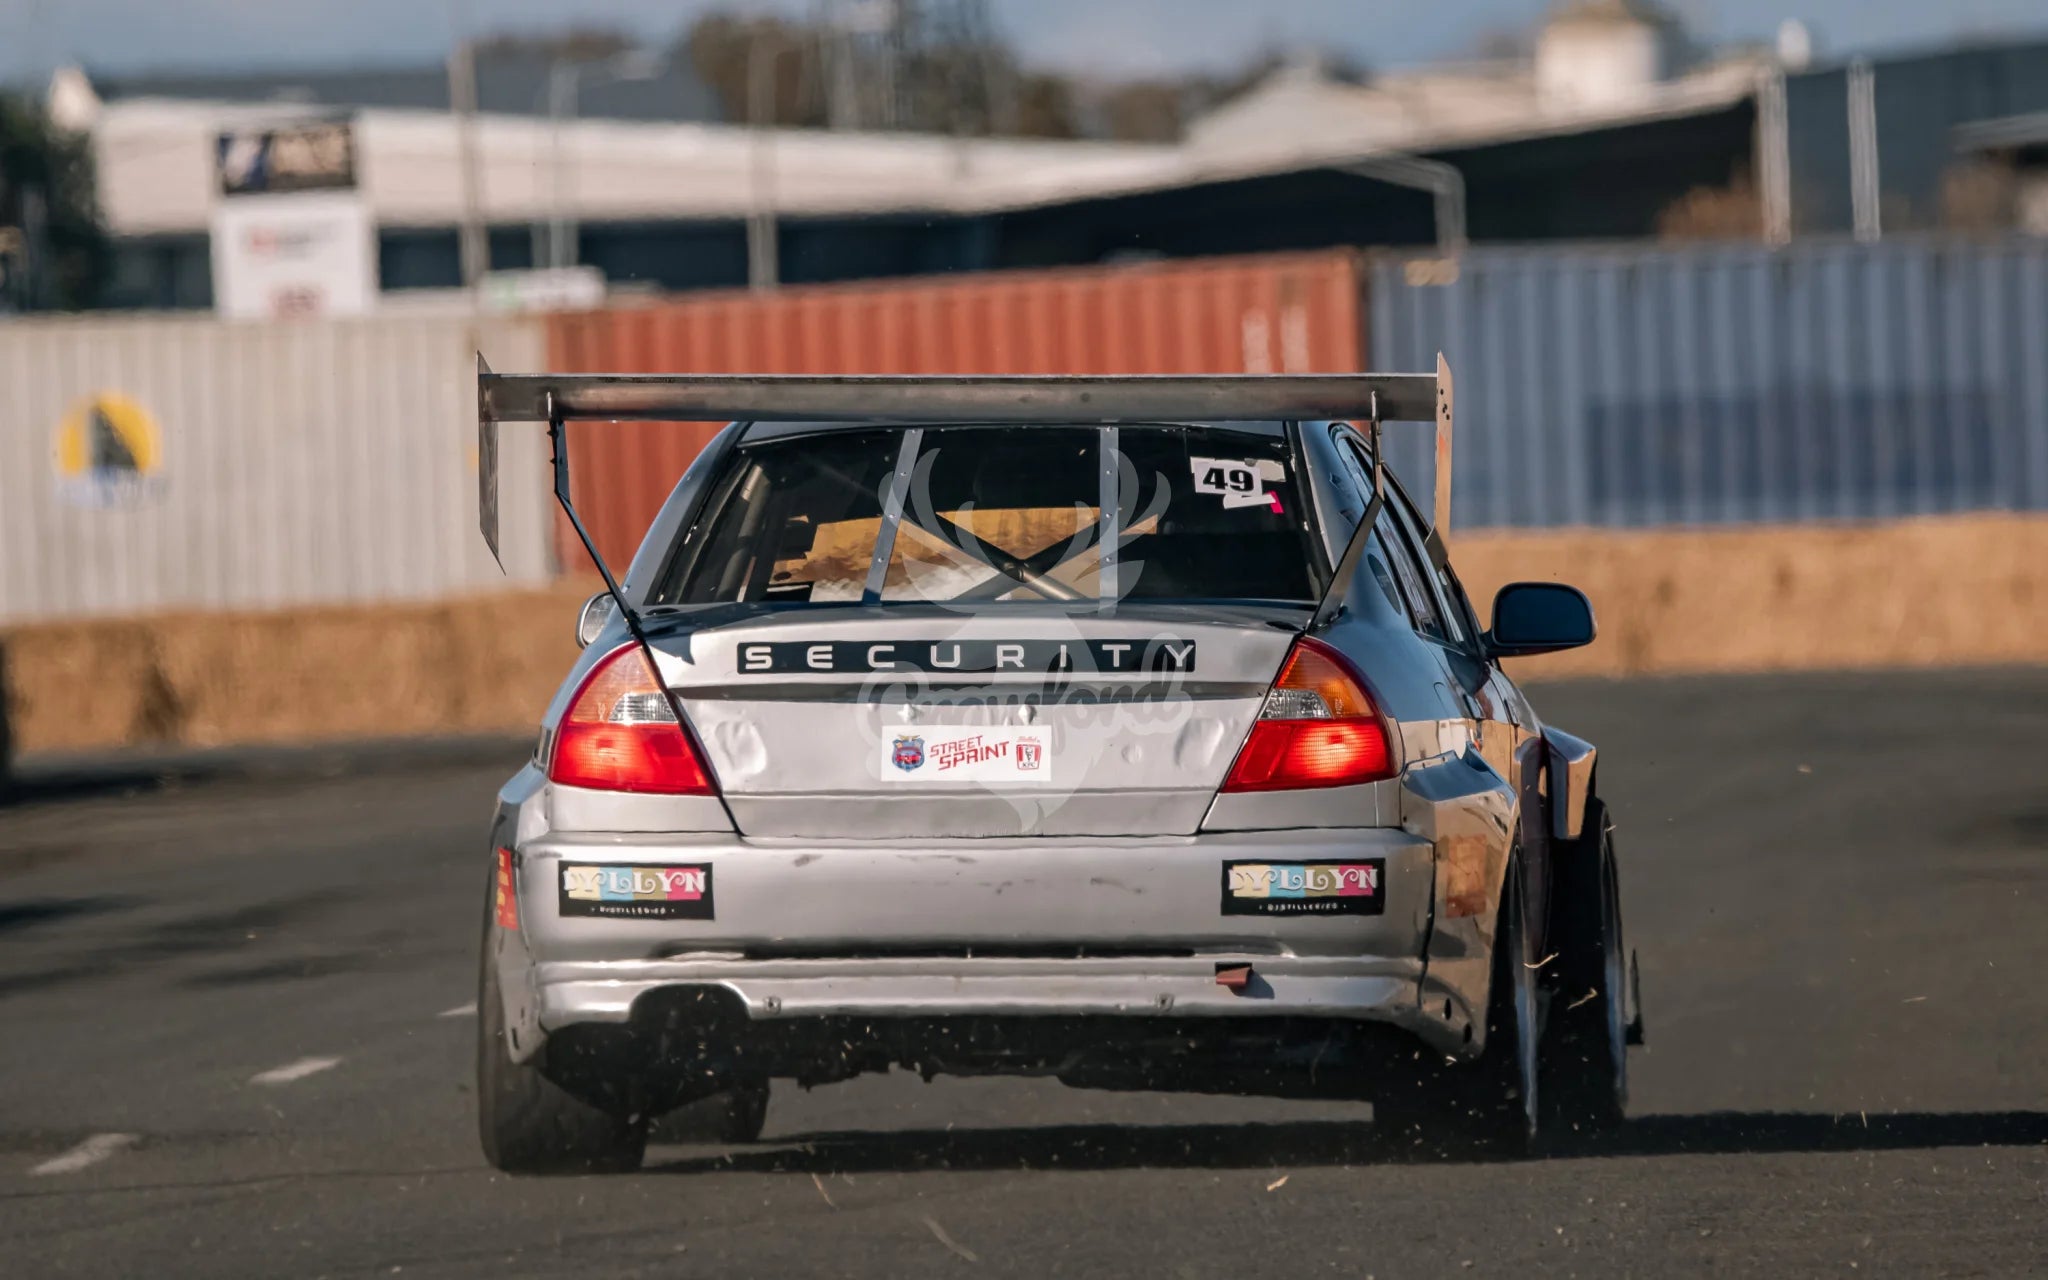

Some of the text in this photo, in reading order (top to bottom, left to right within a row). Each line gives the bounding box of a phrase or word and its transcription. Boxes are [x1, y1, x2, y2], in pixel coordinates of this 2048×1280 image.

[1203, 468, 1254, 492] 49
[745, 643, 1194, 669] SECURITY
[930, 735, 983, 757] STREET
[938, 741, 1010, 771] SPRINT
[1228, 868, 1378, 891] DYLLYN
